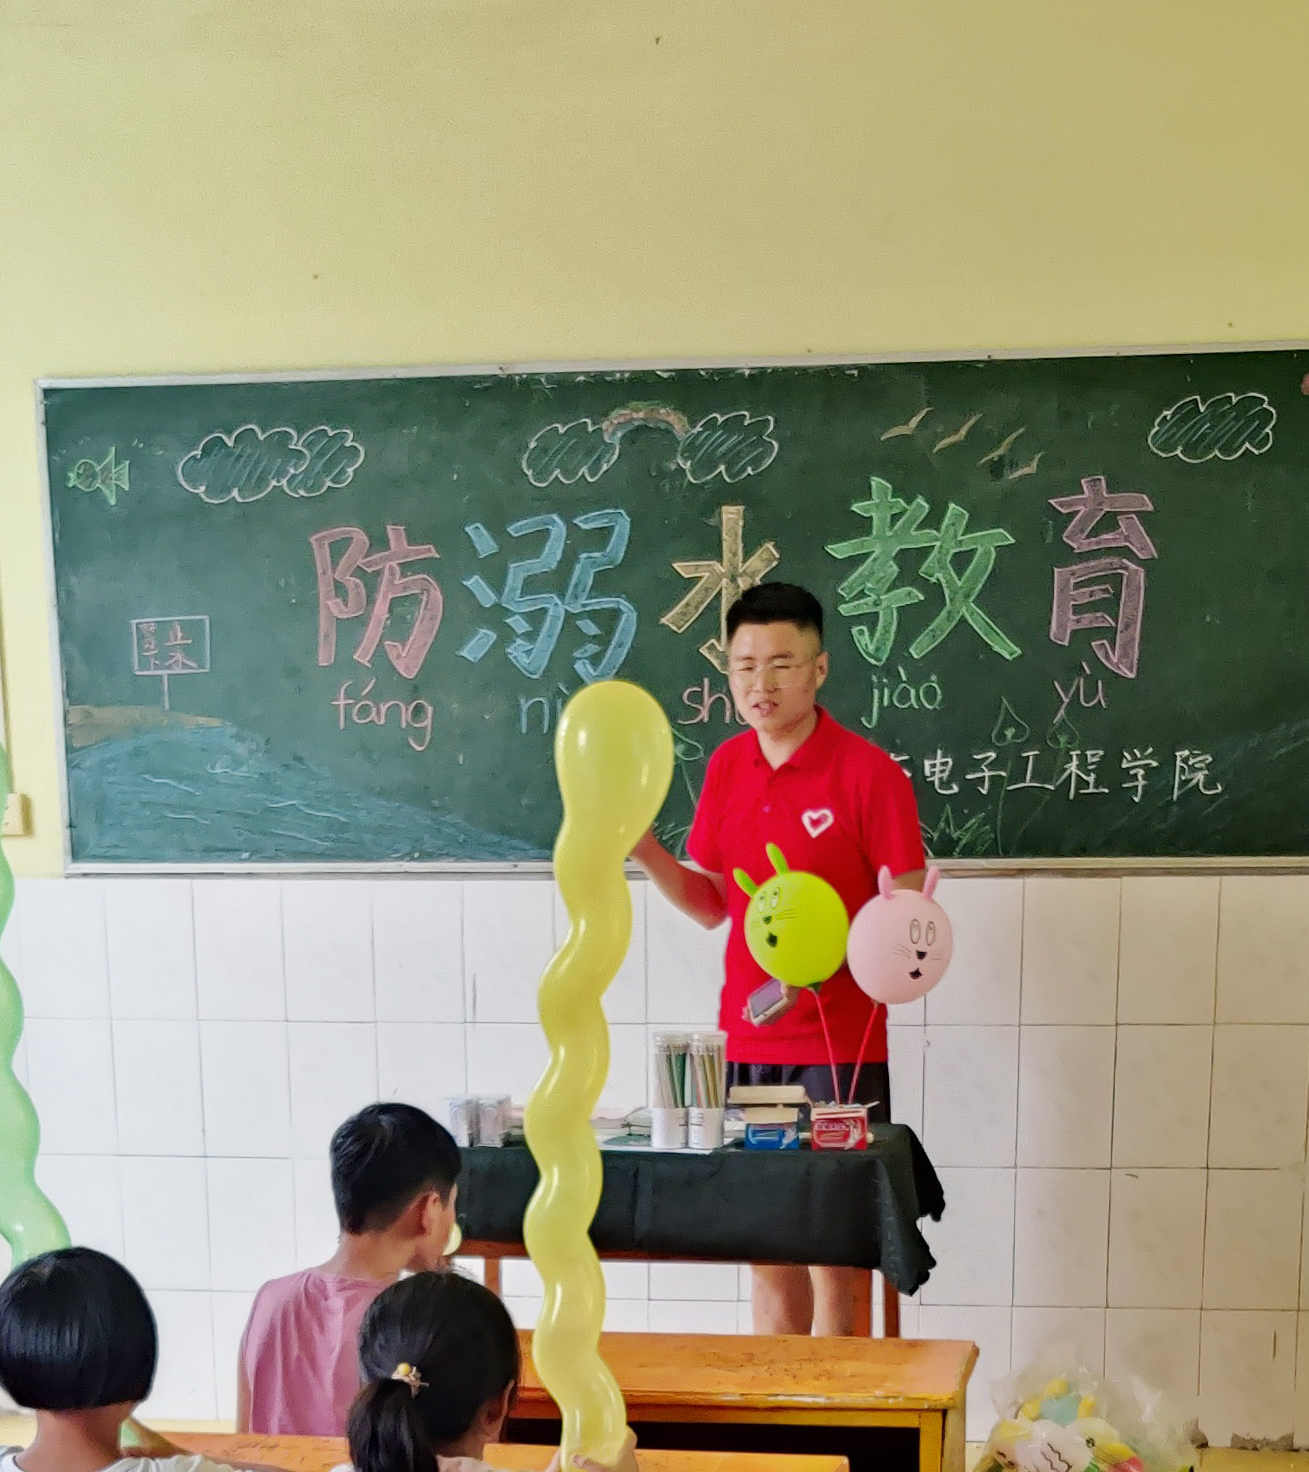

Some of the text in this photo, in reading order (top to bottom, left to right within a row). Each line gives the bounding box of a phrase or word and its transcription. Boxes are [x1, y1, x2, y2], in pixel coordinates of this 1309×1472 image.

[309, 475, 1159, 682] 防溺水教育
[331, 676, 433, 751] fáng
